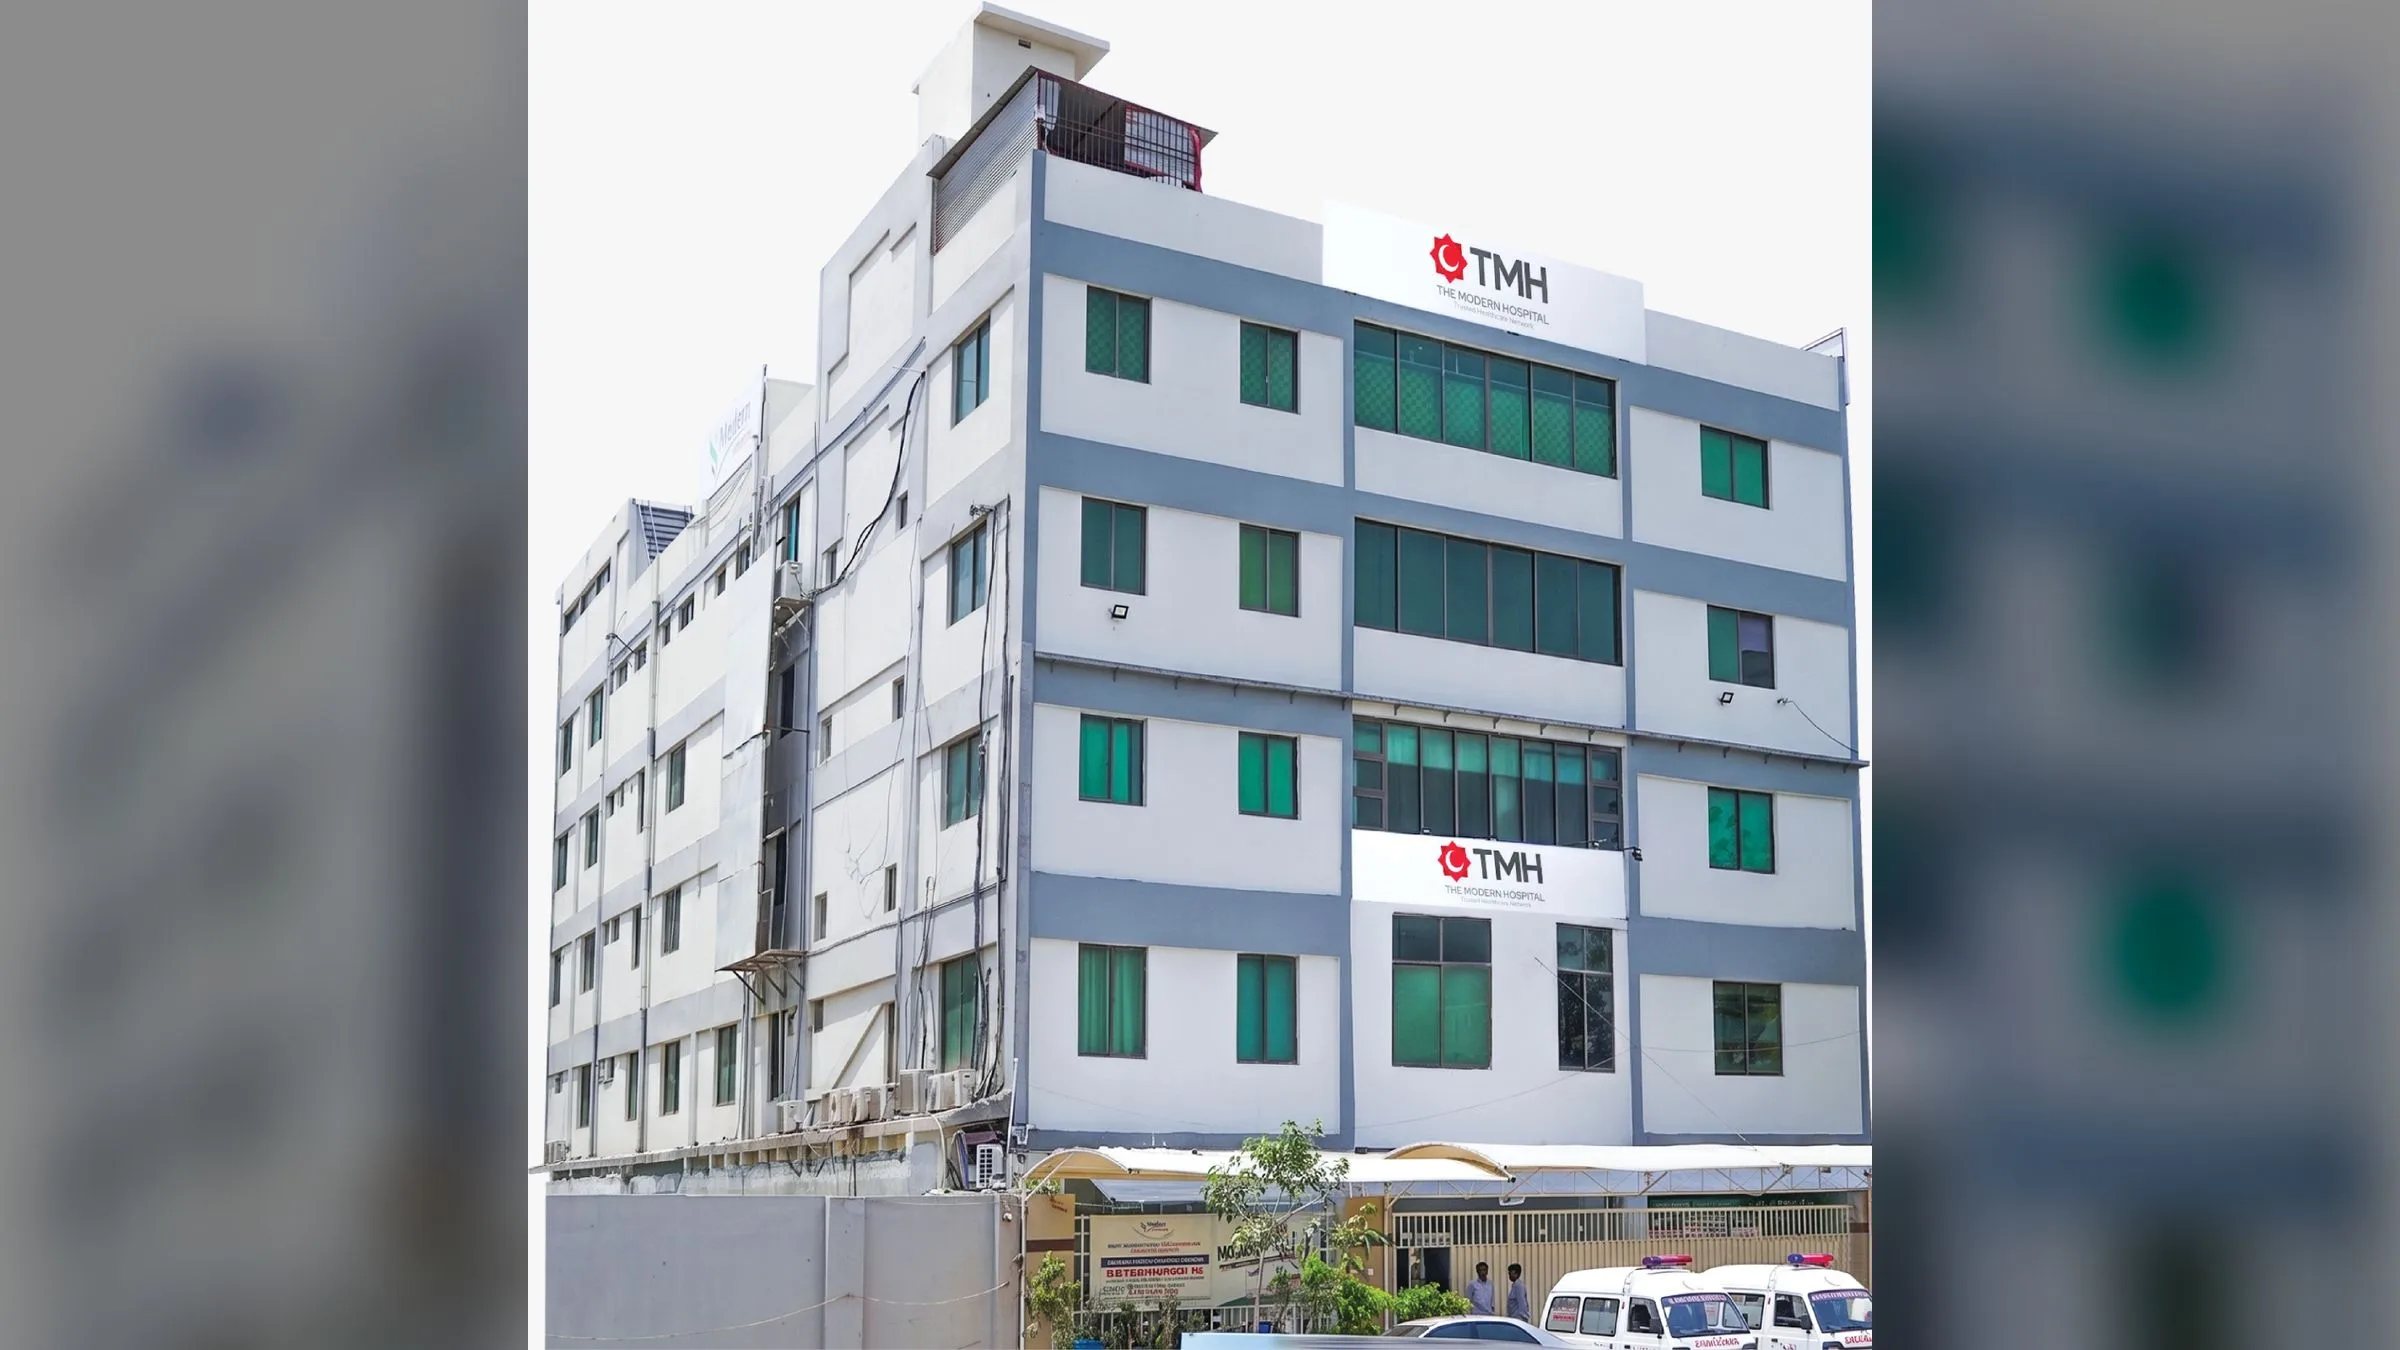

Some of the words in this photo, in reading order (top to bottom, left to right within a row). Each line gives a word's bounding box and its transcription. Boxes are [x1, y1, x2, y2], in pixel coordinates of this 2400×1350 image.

[1470, 247, 1548, 304] TMH
[1437, 285, 1457, 300] THE
[1458, 291, 1500, 311] MODERN
[1502, 304, 1549, 325] HOSPITAL
[1454, 301, 1477, 313] Trusted
[1510, 318, 1534, 330] Network
[1473, 848, 1543, 884] TMH
[1445, 885, 1462, 895] THE
[1464, 887, 1502, 898] MODERN
[1504, 890, 1545, 902] HOSPITAL
